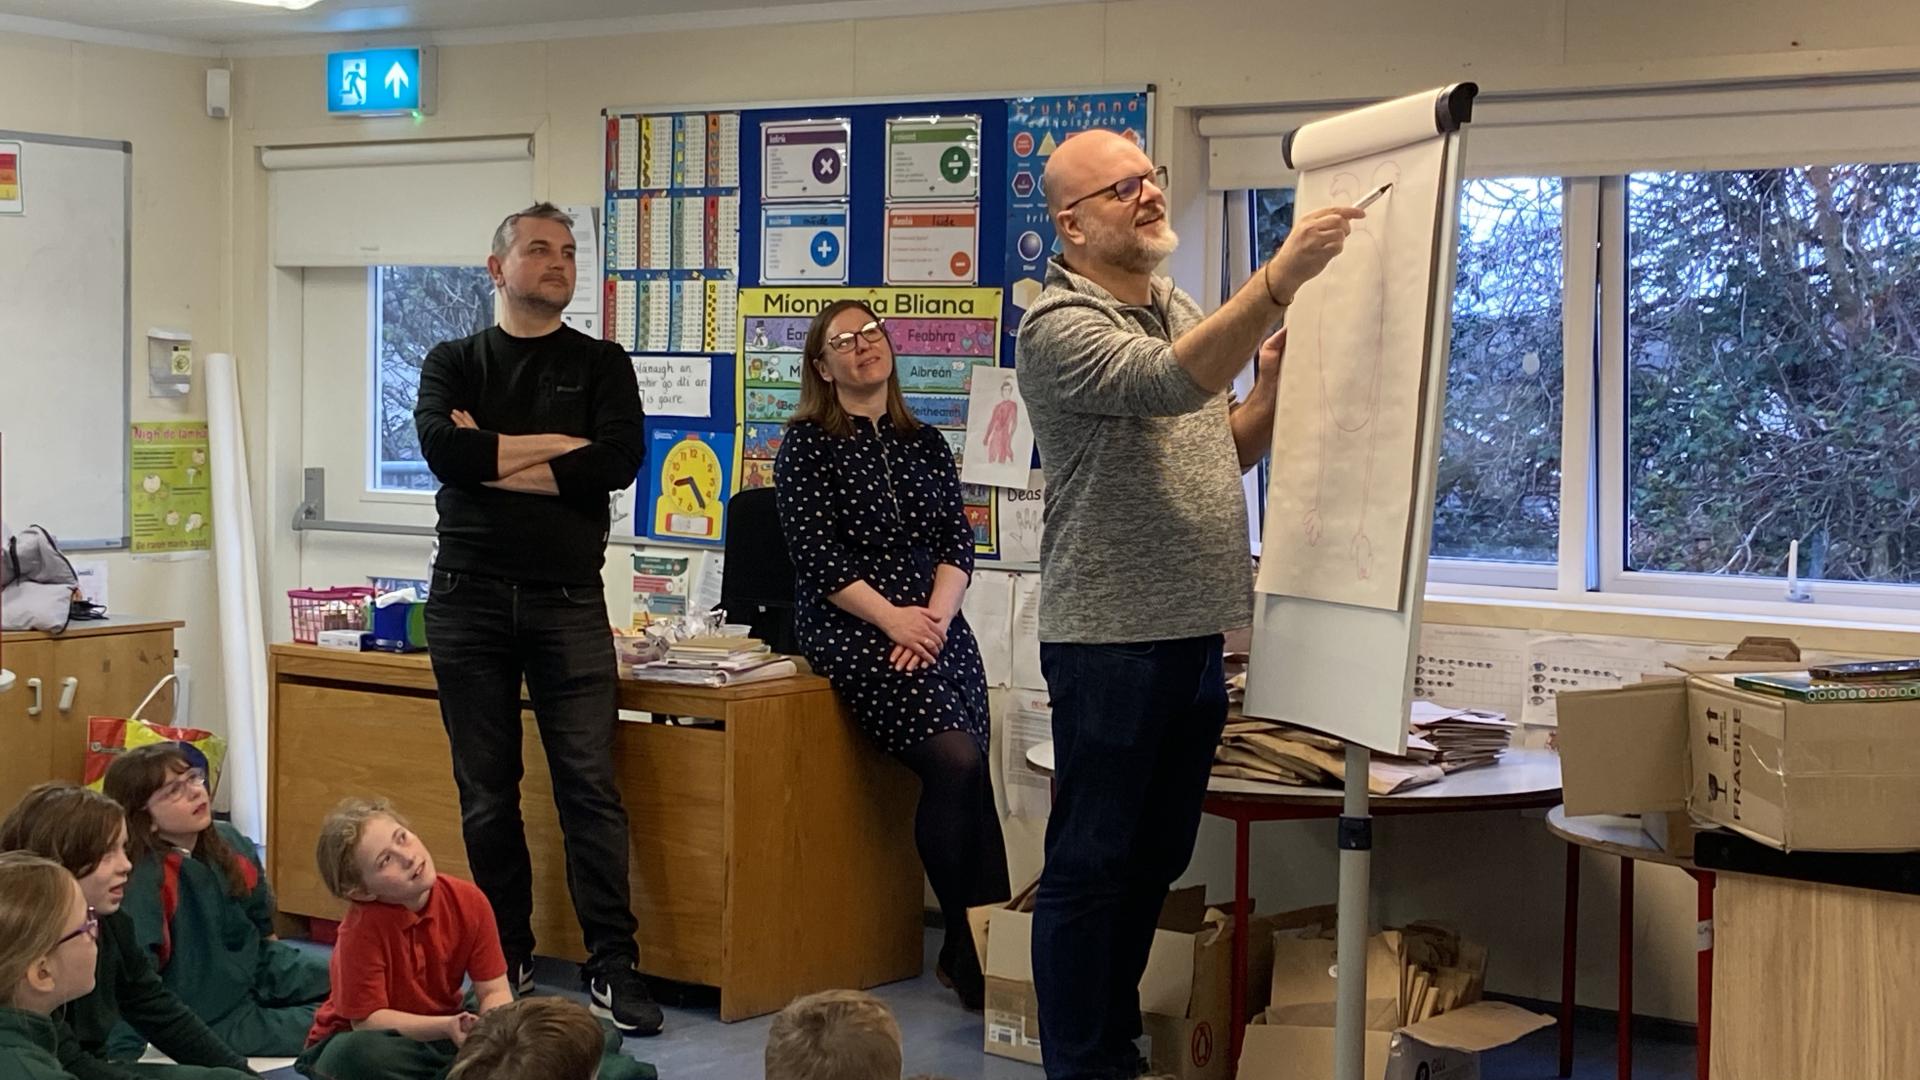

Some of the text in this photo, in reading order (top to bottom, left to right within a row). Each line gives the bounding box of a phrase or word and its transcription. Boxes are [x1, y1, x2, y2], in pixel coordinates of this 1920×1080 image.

[764, 294, 832, 314] Míonn
[895, 294, 974, 314] Bliana
[908, 327, 956, 342] Feabhra
[680, 365, 692, 374] an
[910, 366, 952, 378] Aibreán
[695, 379, 707, 387] an
[909, 405, 961, 417] eitheamh
[1008, 488, 1041, 502] Deas
[1733, 708, 1741, 820] FRAGILE
